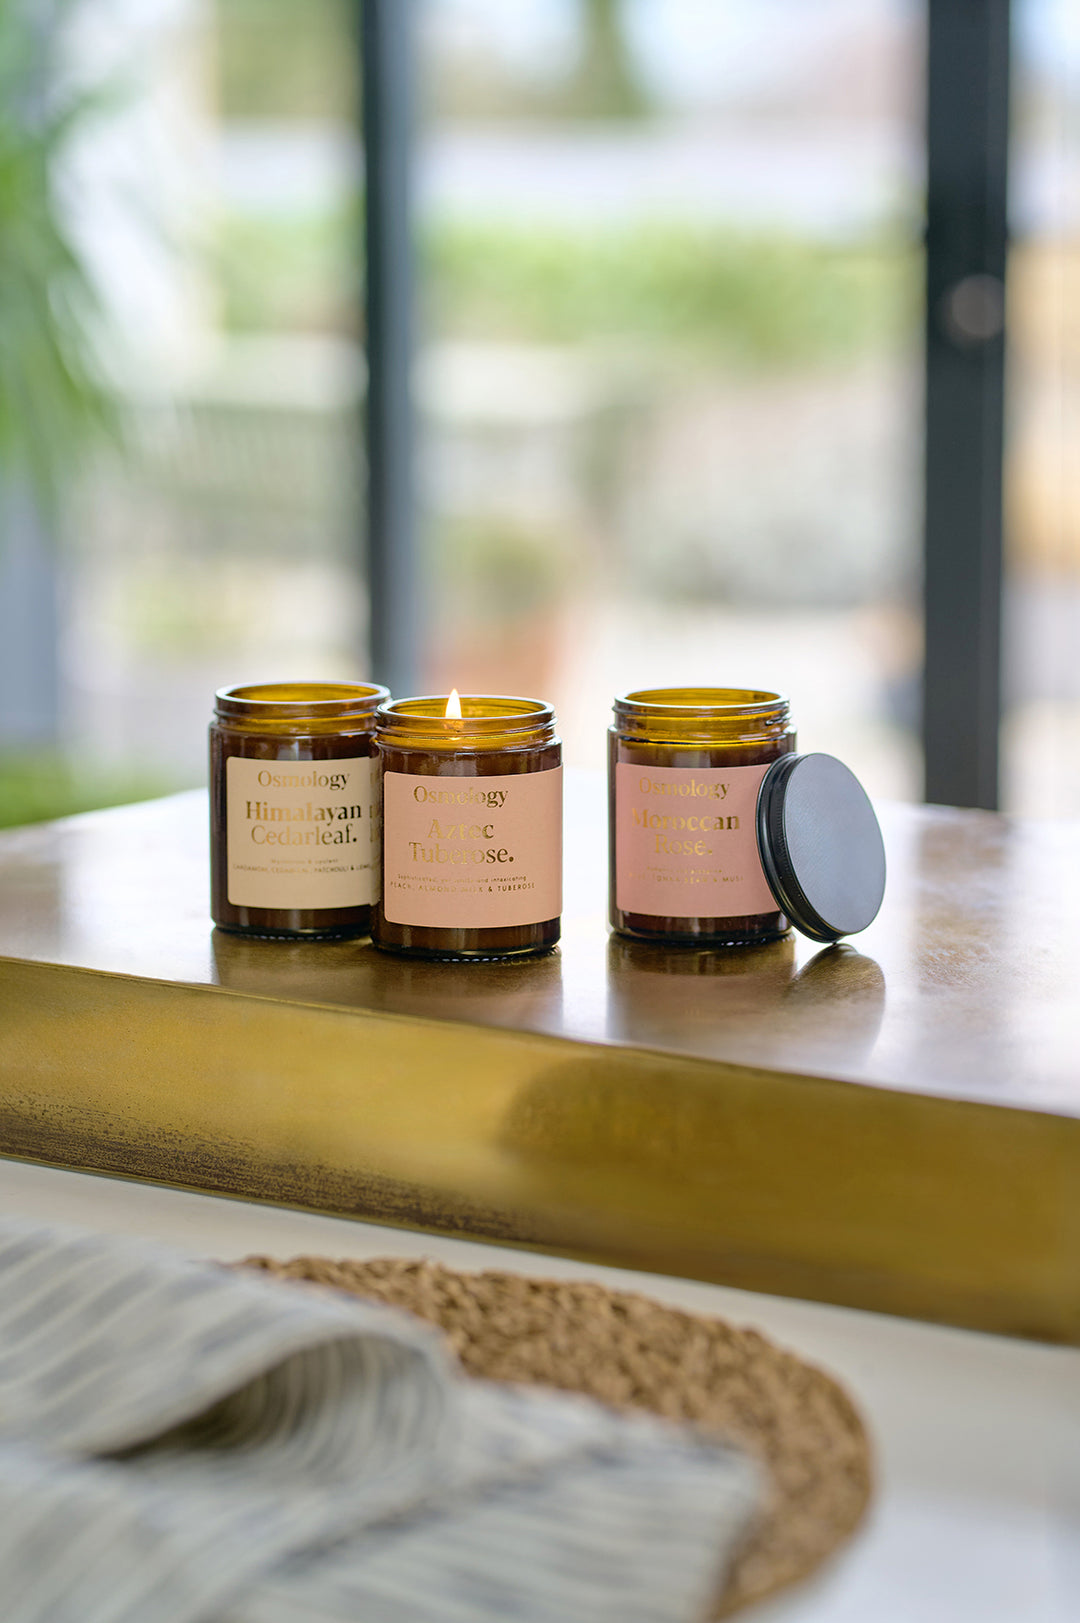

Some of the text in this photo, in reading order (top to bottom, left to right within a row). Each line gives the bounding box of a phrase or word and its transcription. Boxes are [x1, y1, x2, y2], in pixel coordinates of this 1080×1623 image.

[257, 770, 349, 790] Osmology
[639, 777, 730, 800] Osmology
[413, 785, 508, 808] Osmology
[246, 801, 362, 826] Himalayan
[631, 808, 740, 832] Moroccan
[251, 823, 357, 846] Cedarleaf.
[427, 819, 494, 840] Aztec
[409, 841, 514, 865] Tuberose.
[655, 833, 713, 856] Rose.
[497, 882, 536, 892] TUBEROSE
